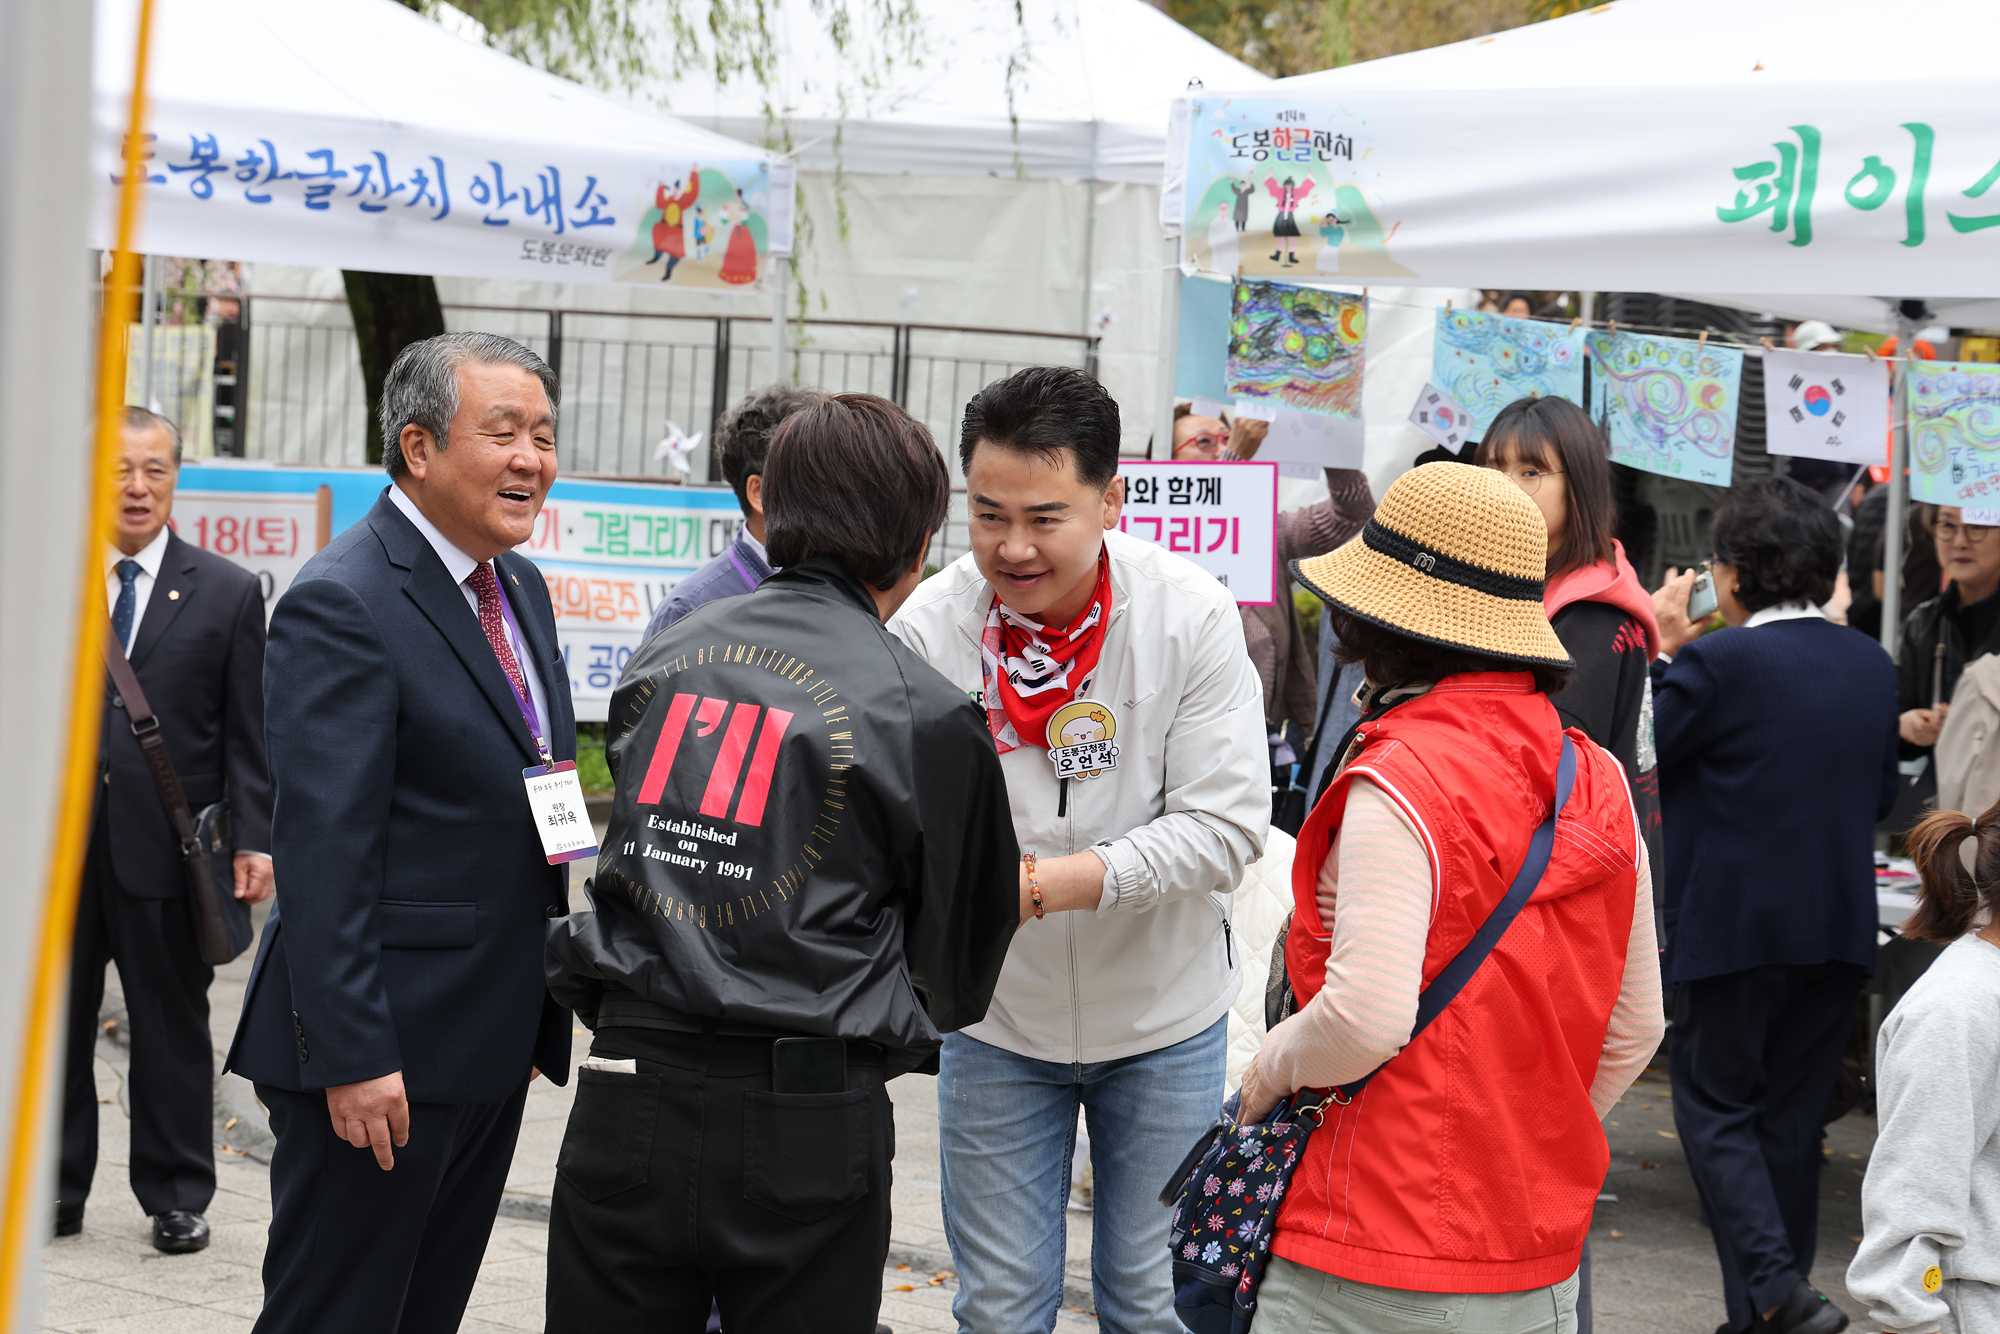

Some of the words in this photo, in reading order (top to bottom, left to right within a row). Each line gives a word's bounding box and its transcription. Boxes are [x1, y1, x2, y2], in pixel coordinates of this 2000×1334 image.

[467, 160, 616, 234] 안내소
[520, 239, 612, 268] 도봉문화원
[1168, 476, 1221, 505] 함께
[193, 515, 299, 558] 18(토)
[582, 511, 702, 560] 그림그리기
[709, 518, 746, 557] 대
[698, 645, 715, 665] BE
[822, 705, 850, 725] BE
[637, 693, 794, 827] I'll
[829, 730, 854, 771] WITH
[1062, 742, 1107, 757] 도봉구청장
[547, 810, 577, 827] 최귀옥
[646, 813, 738, 847] Established
[623, 841, 636, 856] 11
[642, 843, 709, 874] January
[716, 860, 753, 881] 1991
[677, 839, 699, 853] on
